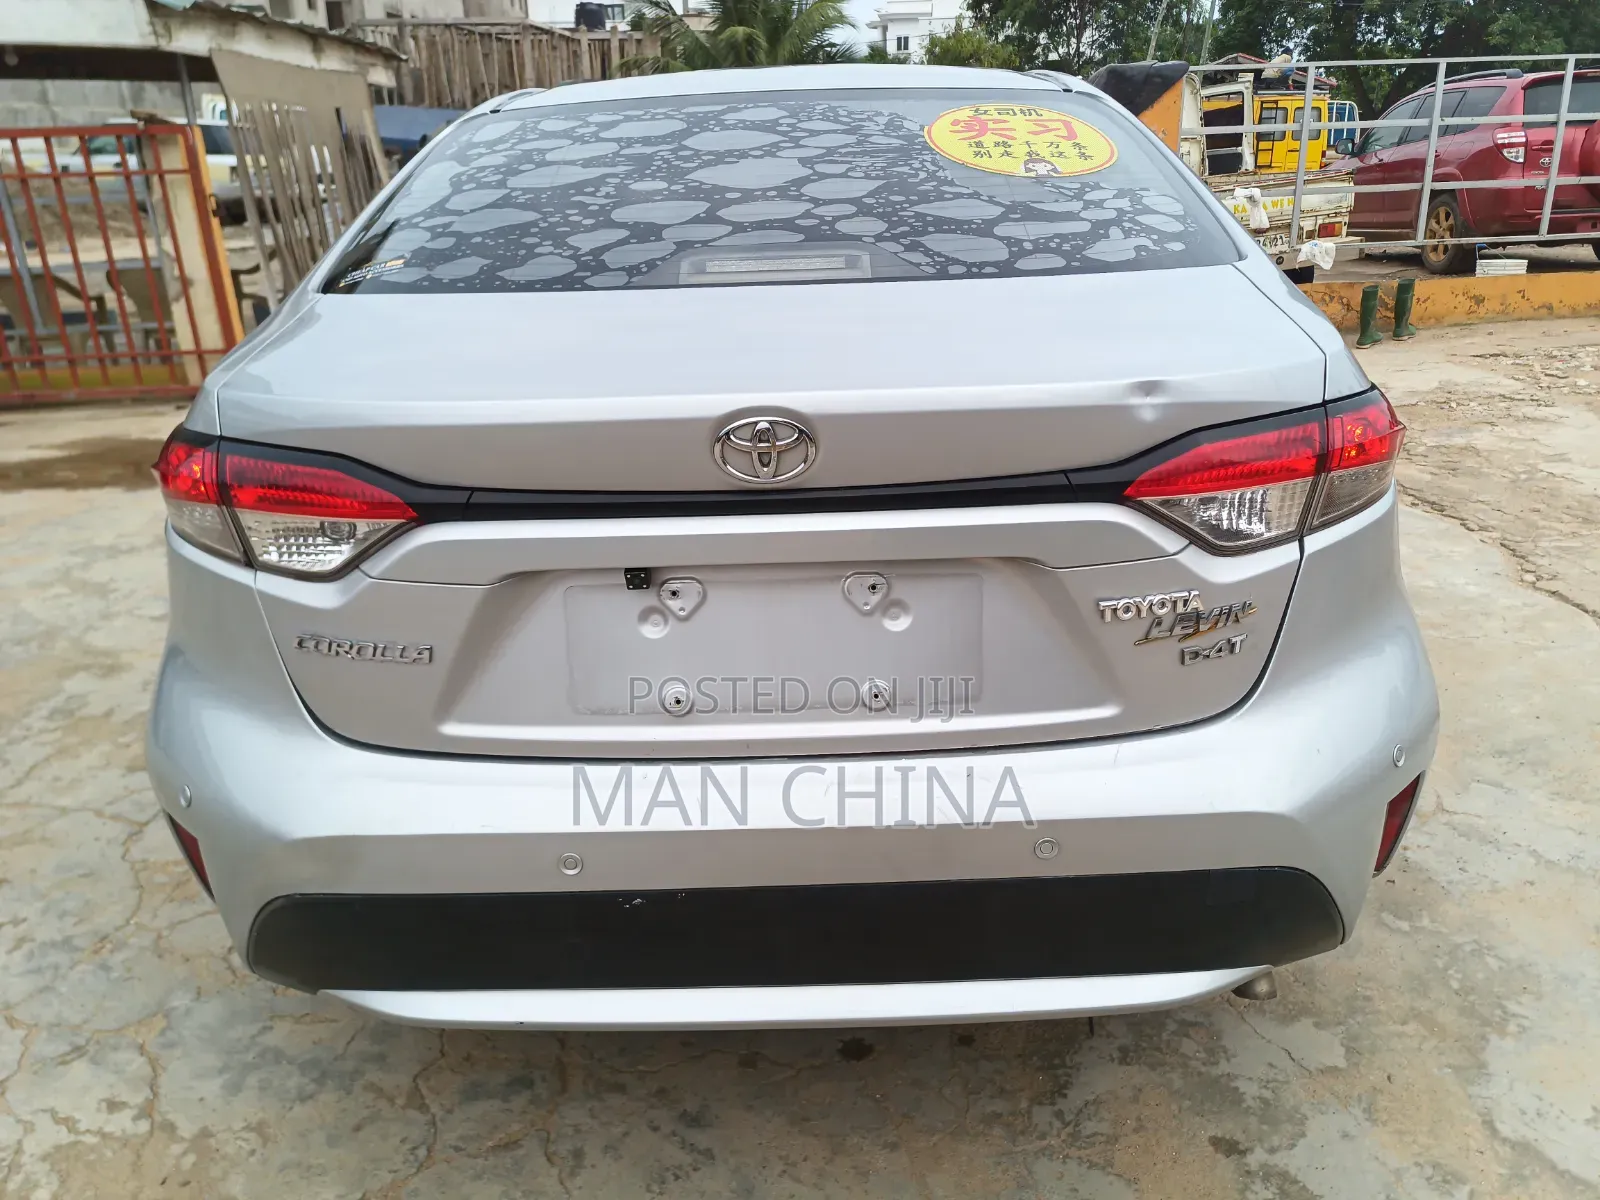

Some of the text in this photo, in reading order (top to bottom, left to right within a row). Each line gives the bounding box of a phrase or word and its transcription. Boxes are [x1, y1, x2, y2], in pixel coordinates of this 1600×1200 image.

[968, 107, 1043, 117] 女司机
[949, 116, 1078, 141] 实习
[967, 140, 1089, 151] 道路千万条
[973, 150, 1095, 161] 别走我这条
[1098, 590, 1205, 623] TOYOTA
[295, 634, 432, 664] COROLLA
[1180, 632, 1248, 666] D-4T
